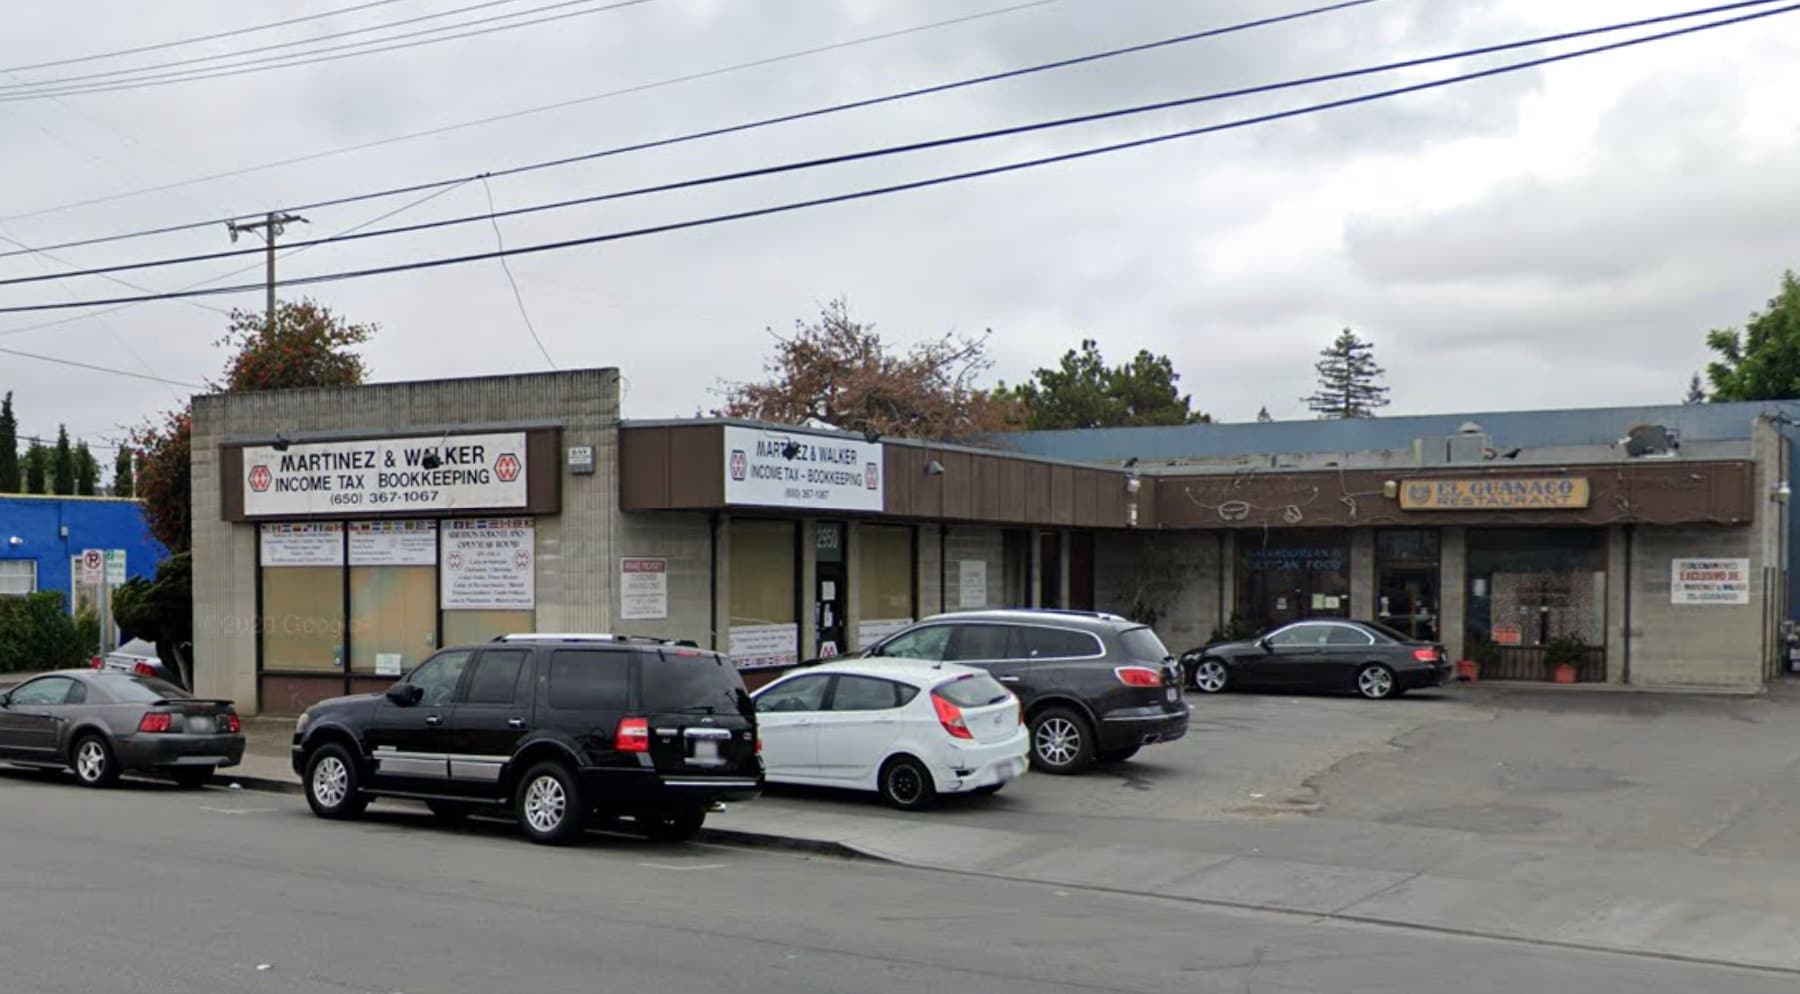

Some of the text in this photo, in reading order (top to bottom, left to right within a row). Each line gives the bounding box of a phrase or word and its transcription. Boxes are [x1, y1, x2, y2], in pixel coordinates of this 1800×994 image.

[280, 445, 484, 472] MARTINEZ & WLKER
[810, 445, 816, 461] &
[819, 446, 857, 465] WALKER
[275, 467, 490, 492] INCOME TAX BOOKKEEPING
[750, 464, 782, 480] INCOME
[785, 467, 799, 481] TAX
[808, 469, 862, 487] BOOKKEEPING
[330, 490, 439, 505] (650) 367-1067
[1437, 481, 1573, 497] EL GUANACO
[1437, 496, 1572, 505] RESTAURANT
[816, 528, 839, 549] 2950
[1305, 559, 1341, 569] FOOD
